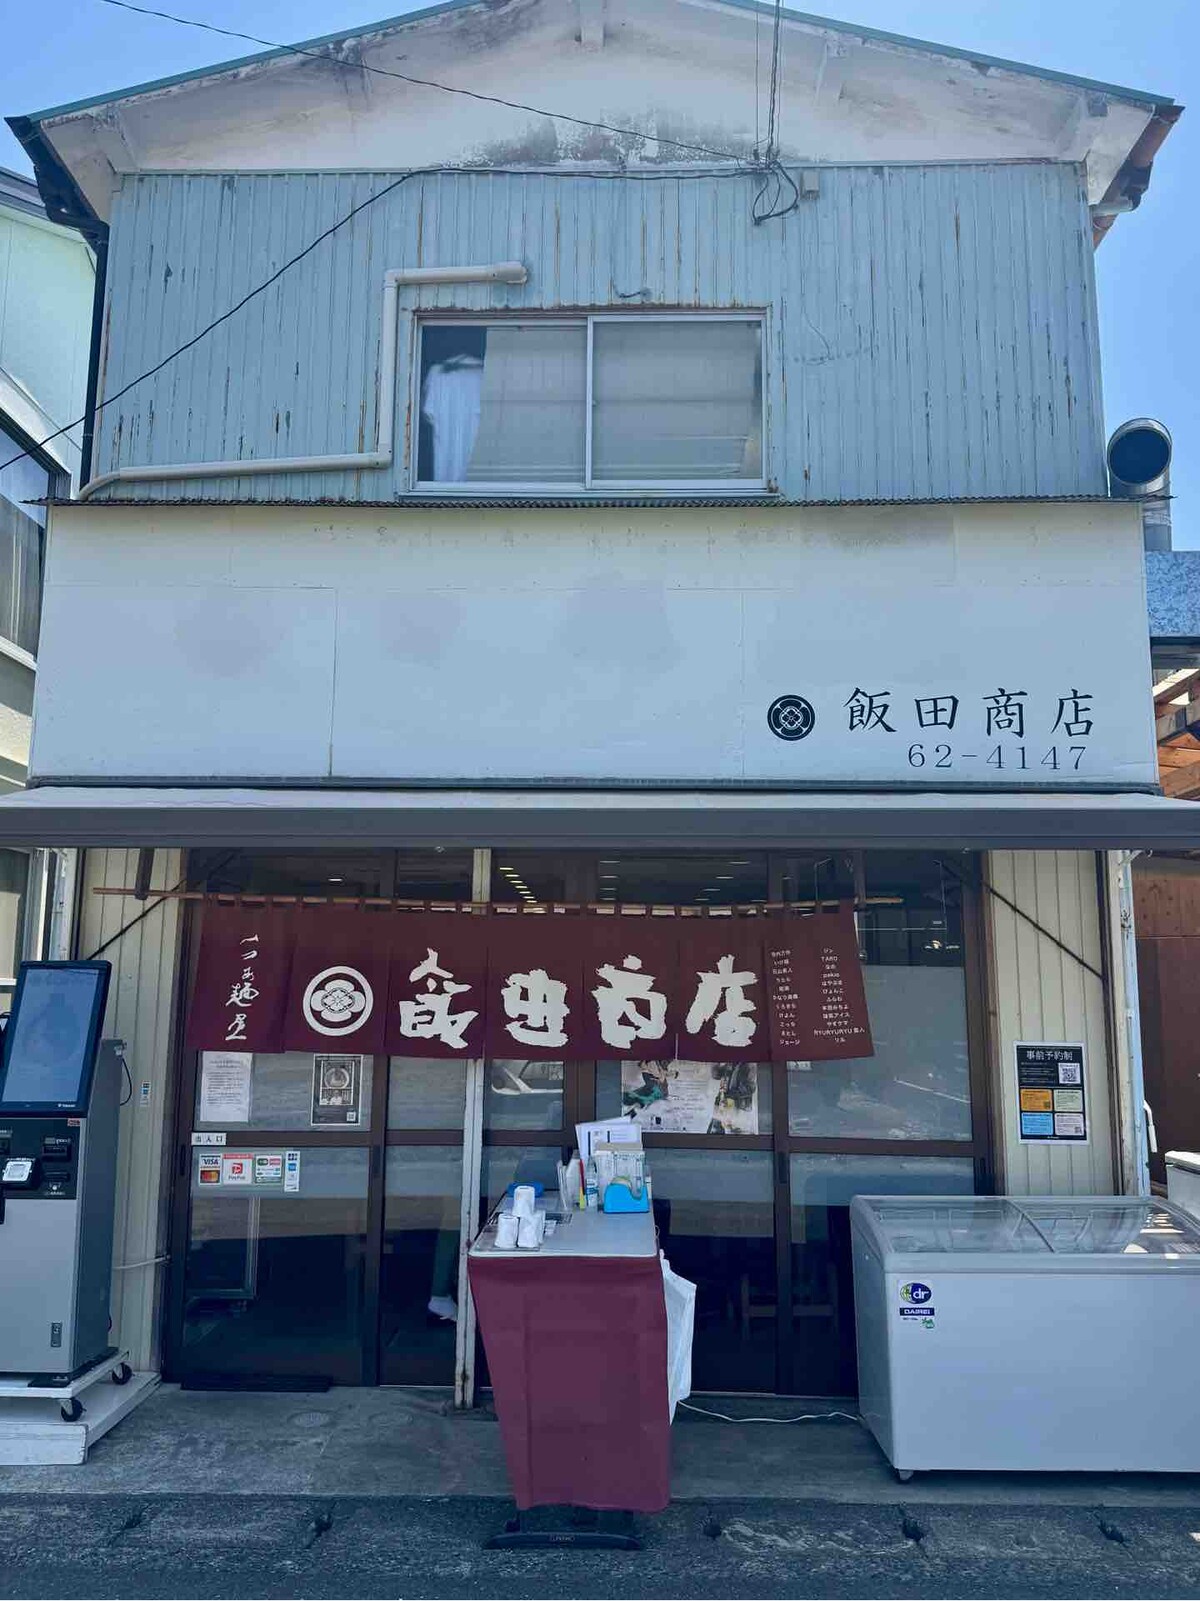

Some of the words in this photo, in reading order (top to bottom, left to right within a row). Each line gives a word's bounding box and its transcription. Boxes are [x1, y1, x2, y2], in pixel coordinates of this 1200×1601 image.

[843, 687, 1094, 738] 飯田商店
[907, 744, 1087, 771] 62-4147
[203, 1158, 219, 1166] VISA
[913, 1287, 930, 1300] dr
